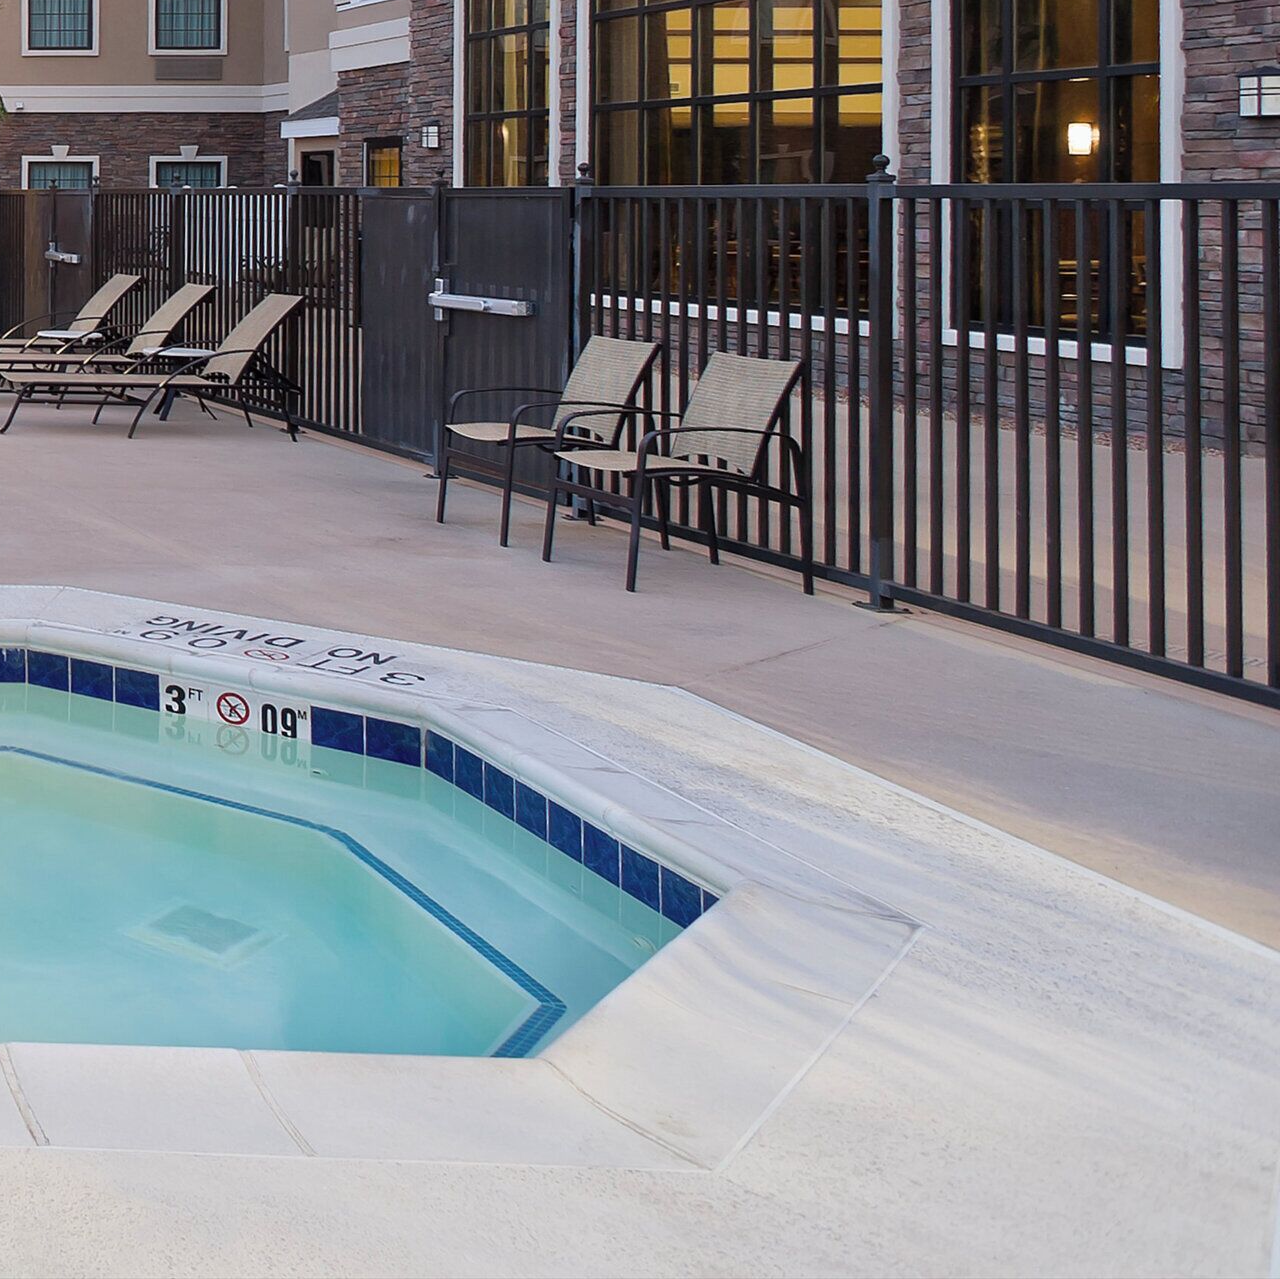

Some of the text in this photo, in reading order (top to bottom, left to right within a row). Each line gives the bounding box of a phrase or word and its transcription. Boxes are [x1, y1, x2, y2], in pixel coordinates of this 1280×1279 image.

[145, 616, 398, 665] NO DIVING
[296, 658, 371, 675] FT
[379, 672, 425, 685] 3
[165, 684, 187, 715] 3
[188, 687, 203, 701] FT
